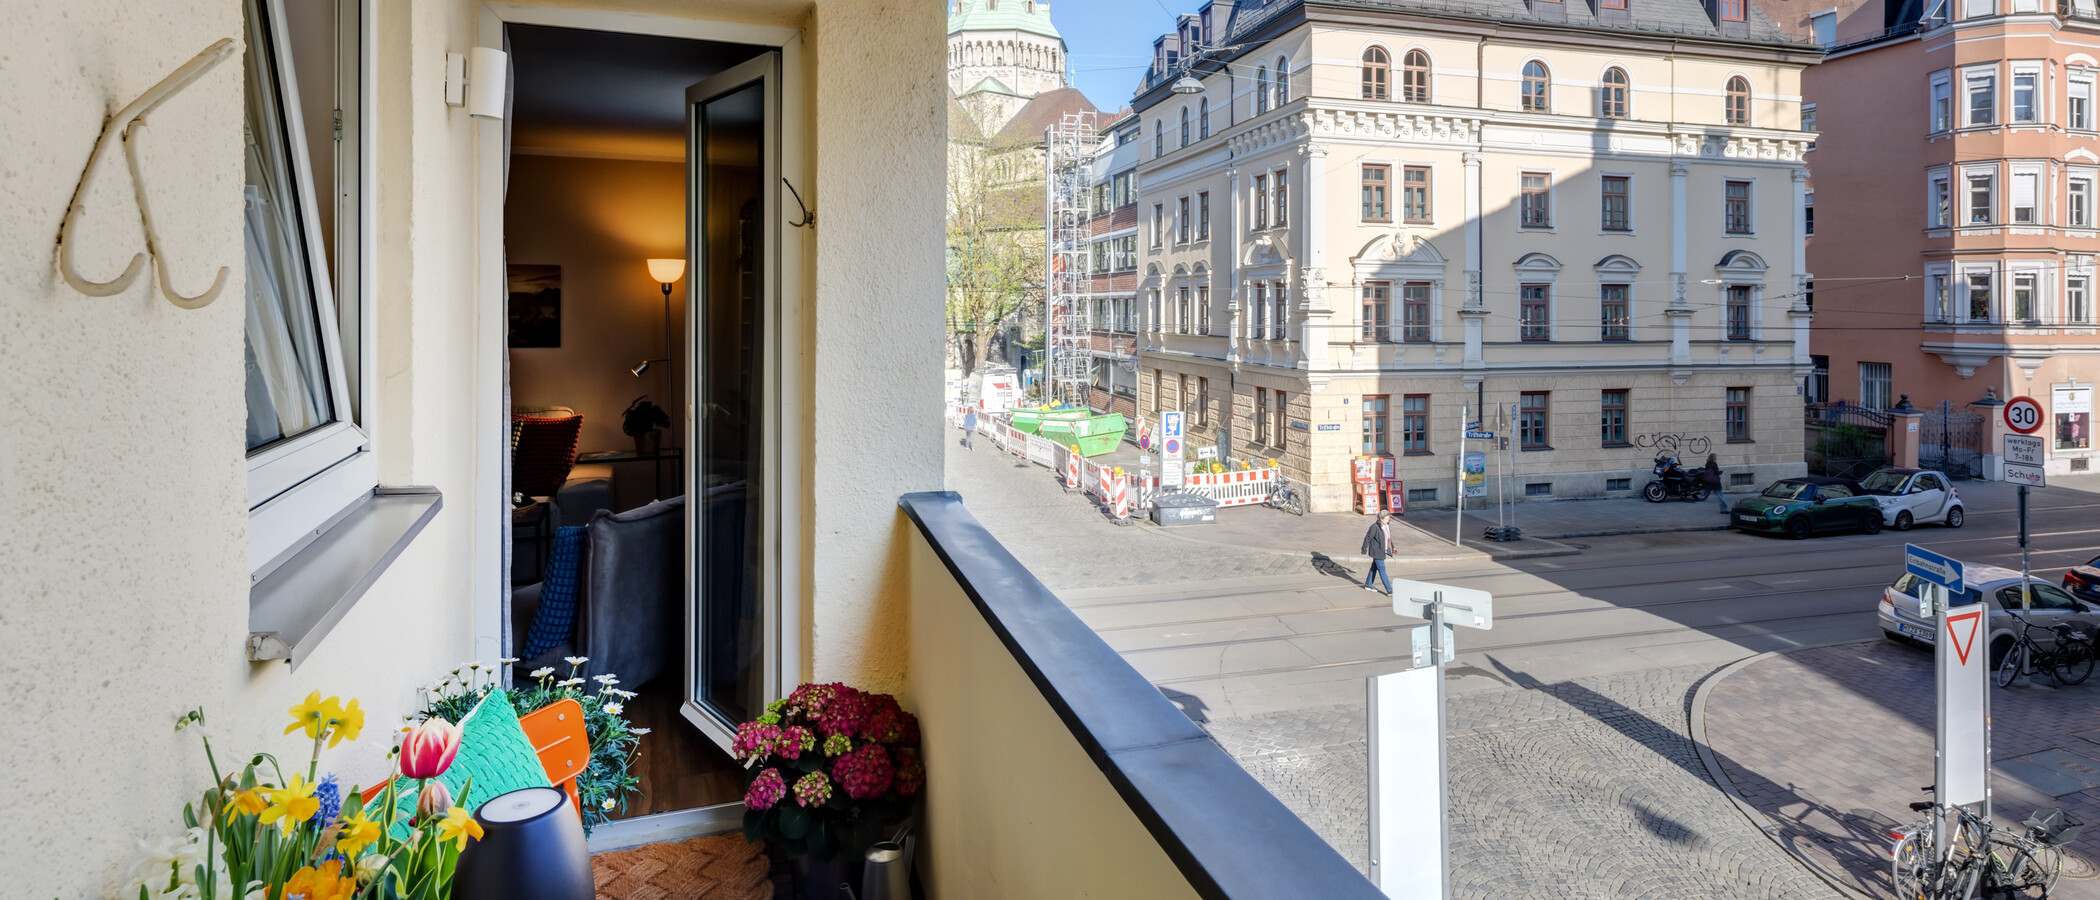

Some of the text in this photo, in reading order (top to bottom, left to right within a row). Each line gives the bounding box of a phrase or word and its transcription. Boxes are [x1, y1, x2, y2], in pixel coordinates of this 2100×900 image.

[2012, 407, 2035, 424] 30
[2007, 438, 2041, 448] werktags
[2012, 445, 2035, 454] Mo-Fr
[2015, 453, 2034, 462] 7-18h
[1909, 555, 1946, 576] Einbahnstraße
